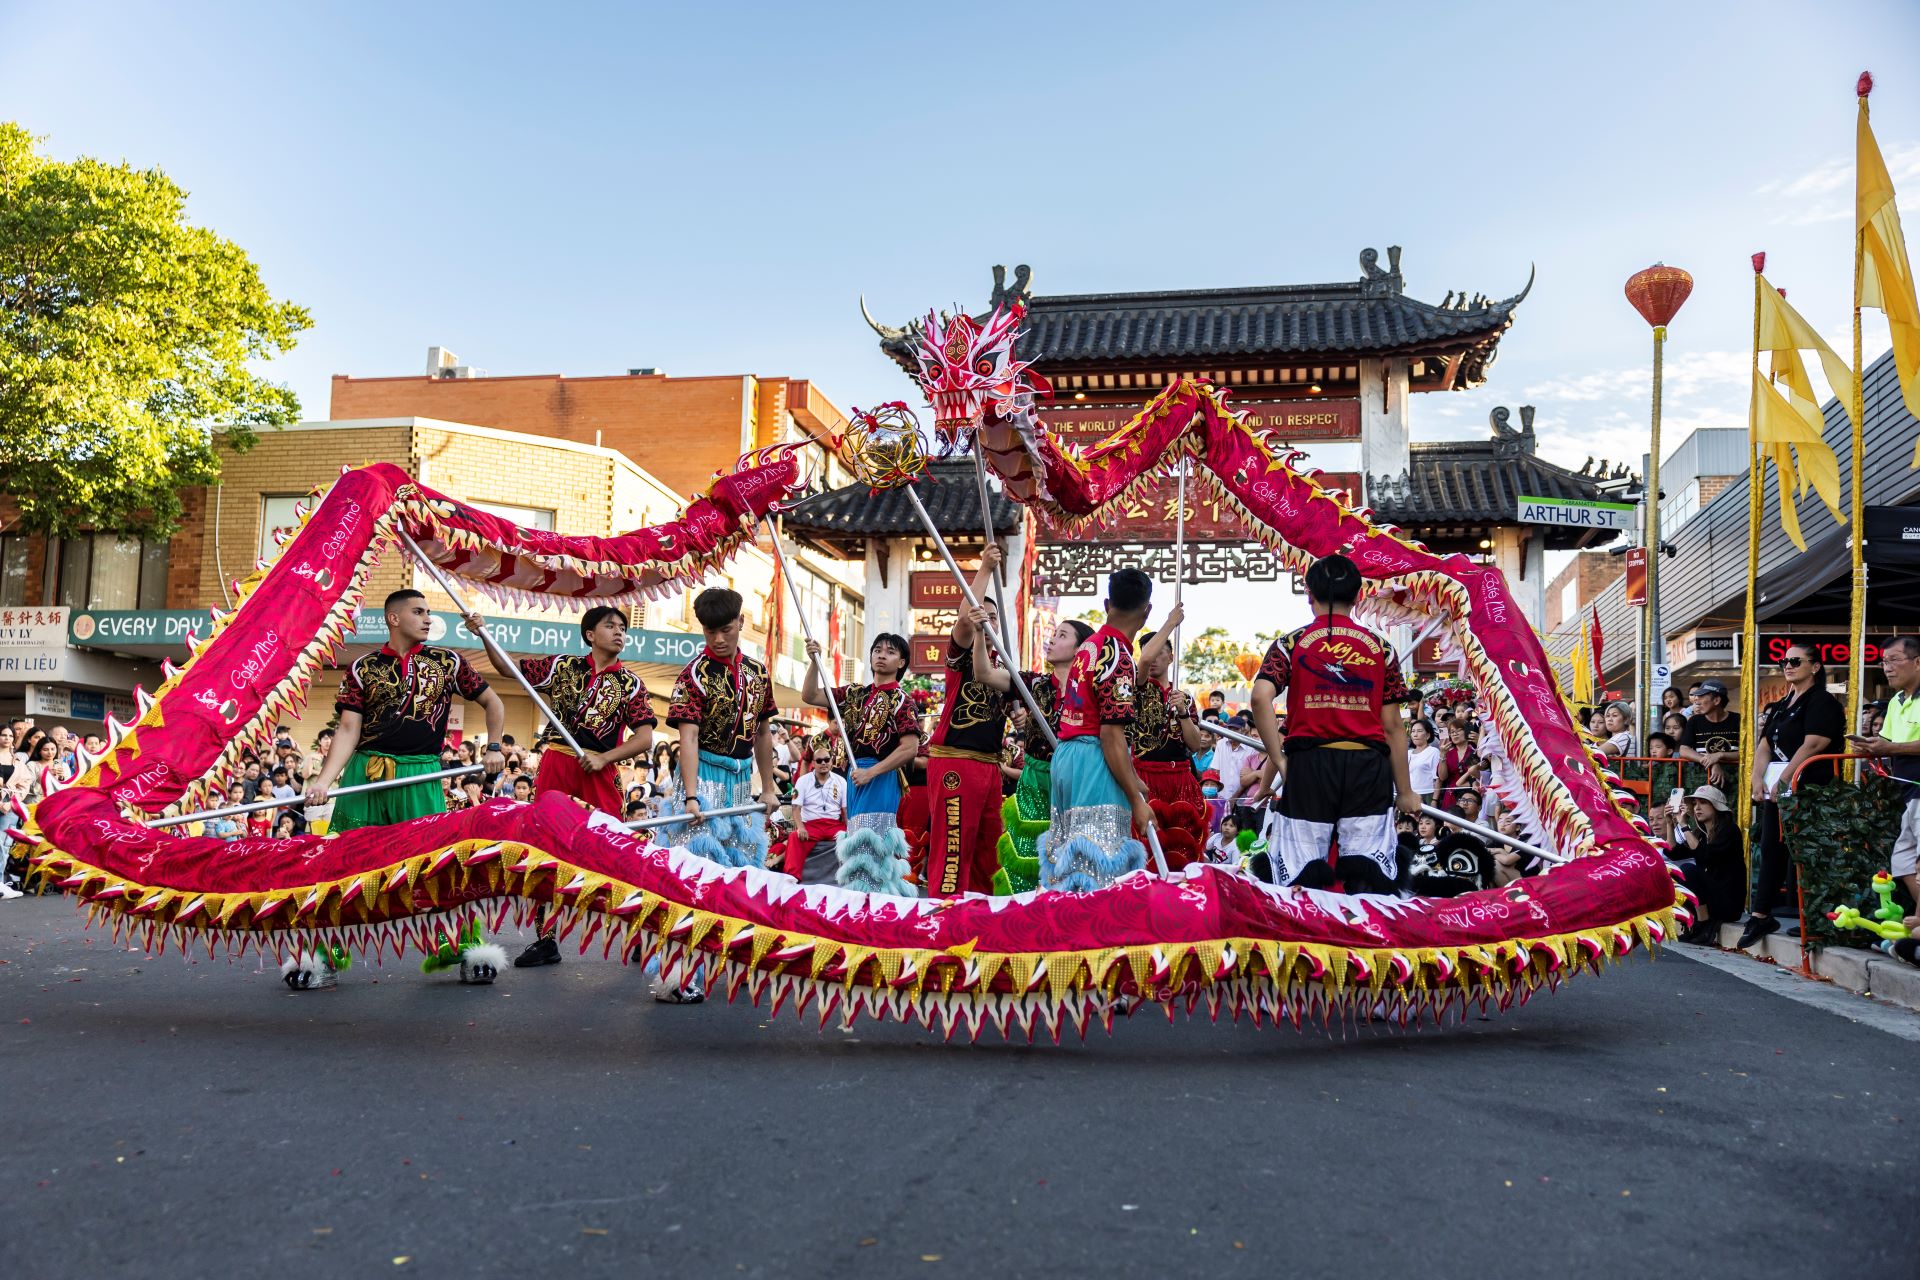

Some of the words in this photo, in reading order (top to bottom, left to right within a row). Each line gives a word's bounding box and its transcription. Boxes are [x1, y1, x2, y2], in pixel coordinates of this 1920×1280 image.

[1053, 421, 1074, 433] THE
[1079, 420, 1115, 432] WORLD
[1247, 415, 1263, 427] ND
[1269, 415, 1283, 426] TO
[1288, 413, 1339, 426] RESPECT
[1561, 499, 1597, 507] CABRAMATTA
[1523, 505, 1592, 525] ARTHUR
[1597, 510, 1616, 527] ST
[1628, 558, 1645, 567] STOPPING
[923, 585, 964, 596] LIBERT
[20, 628, 33, 639] LY
[98, 616, 157, 636] EVERY
[164, 617, 204, 636] DAY
[455, 621, 521, 646] EERY
[530, 626, 573, 648] DAY
[925, 645, 941, 663] 由
[946, 828, 960, 854] YEE
[940, 854, 960, 894] TONG
